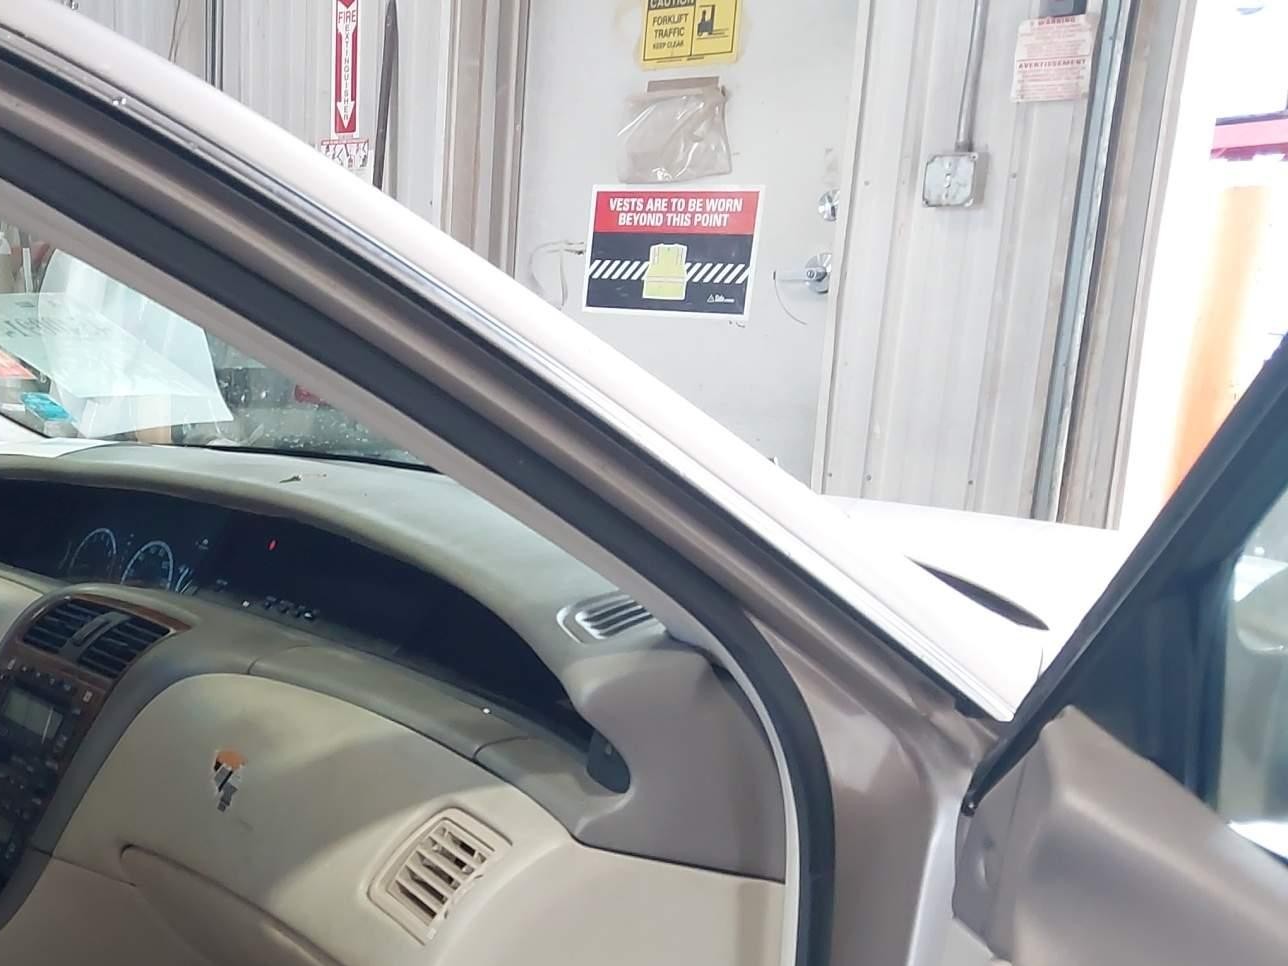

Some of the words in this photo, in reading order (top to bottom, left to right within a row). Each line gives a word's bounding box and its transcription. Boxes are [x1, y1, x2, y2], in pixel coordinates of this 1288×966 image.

[338, 10, 356, 24] FIRE
[652, 13, 688, 26] FORKLIFT
[654, 27, 685, 39] TRAFFIC
[609, 198, 644, 212] VESTS
[645, 198, 669, 212] ARE
[670, 198, 685, 212] TO
[687, 199, 703, 212] BE
[706, 199, 743, 212] WORN
[618, 213, 663, 226] BEYOND
[666, 213, 691, 226] THIS
[693, 213, 729, 227] POINT
